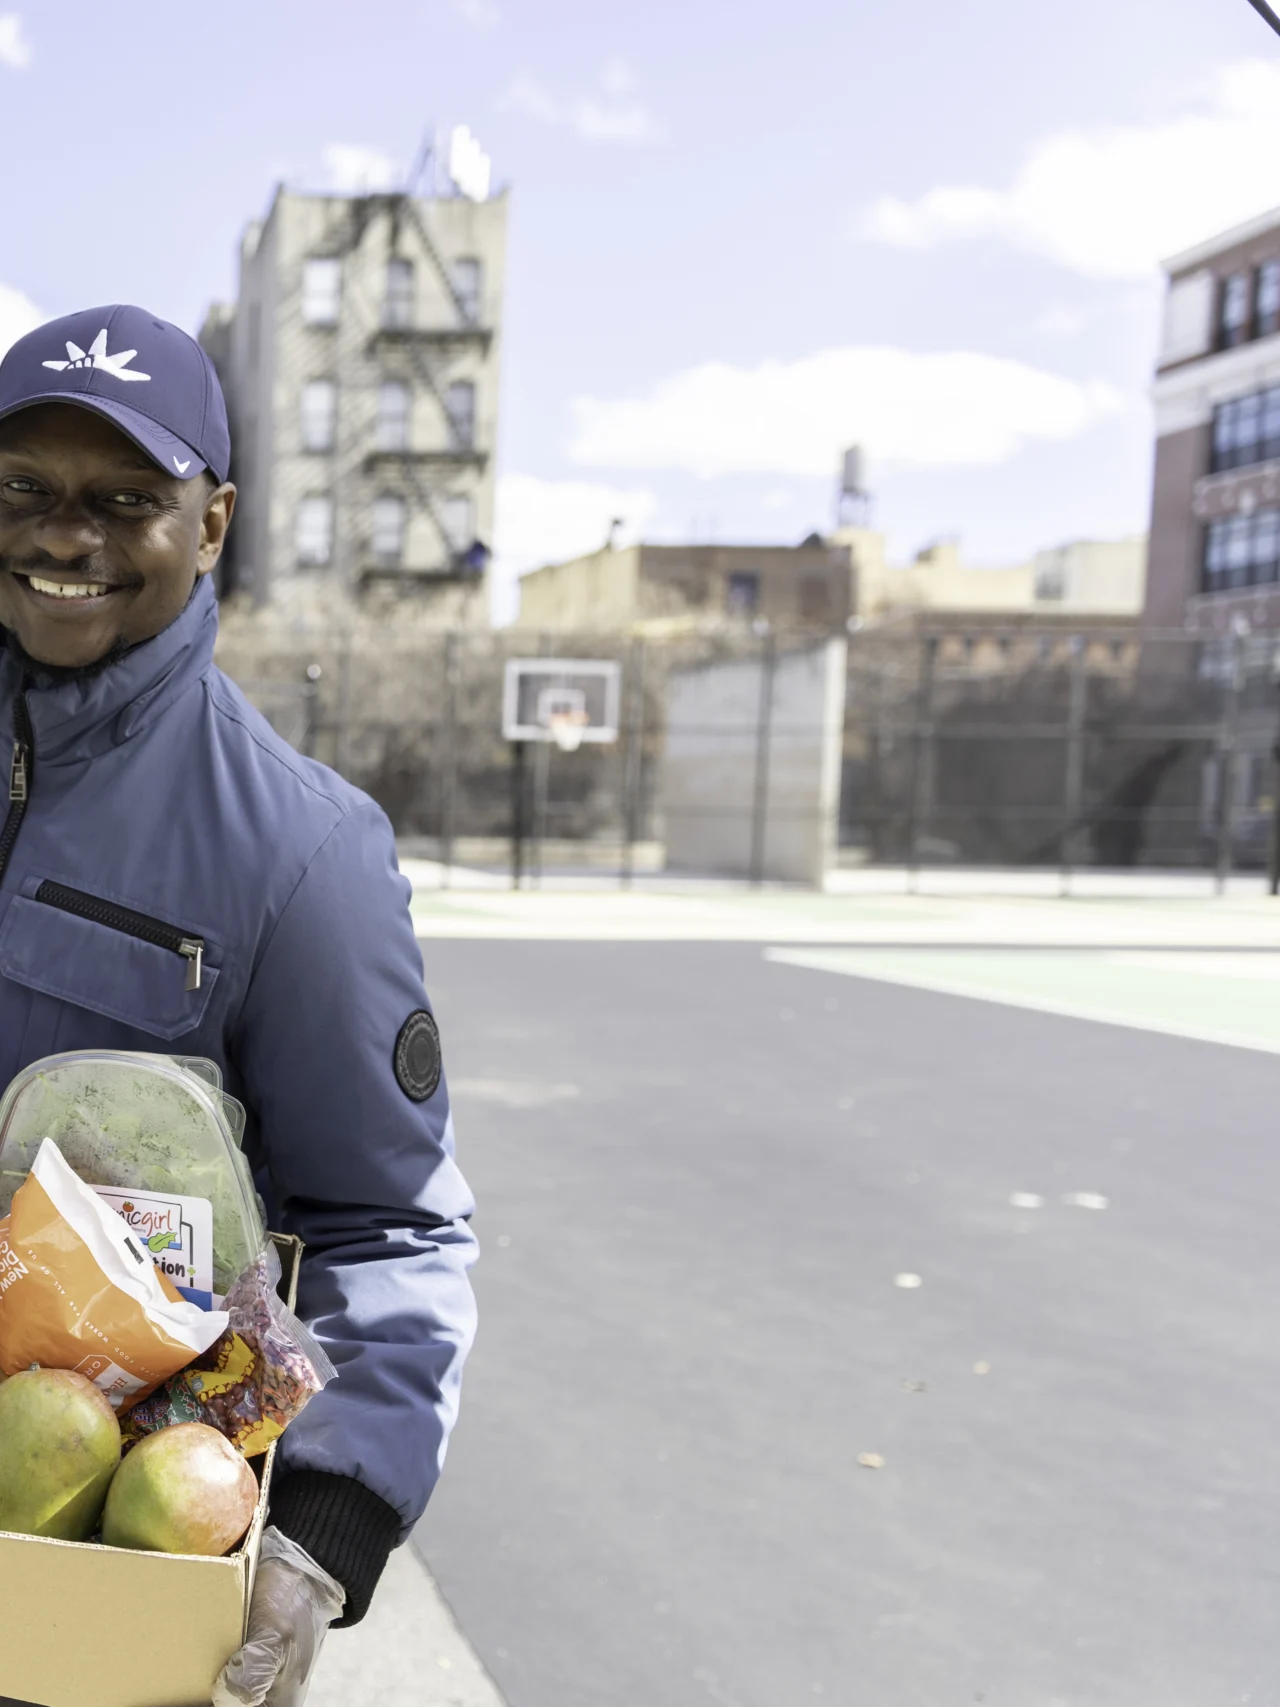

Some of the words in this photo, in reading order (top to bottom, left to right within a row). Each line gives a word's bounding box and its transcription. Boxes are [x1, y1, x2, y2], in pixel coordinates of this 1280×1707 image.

[27, 1249, 37, 1260] US
[0, 1261, 29, 1292] New
[53, 1280, 66, 1295] ALL
[69, 1301, 81, 1317] FOR
[84, 1321, 109, 1343] WORKS
[114, 1347, 134, 1364] FOOD
